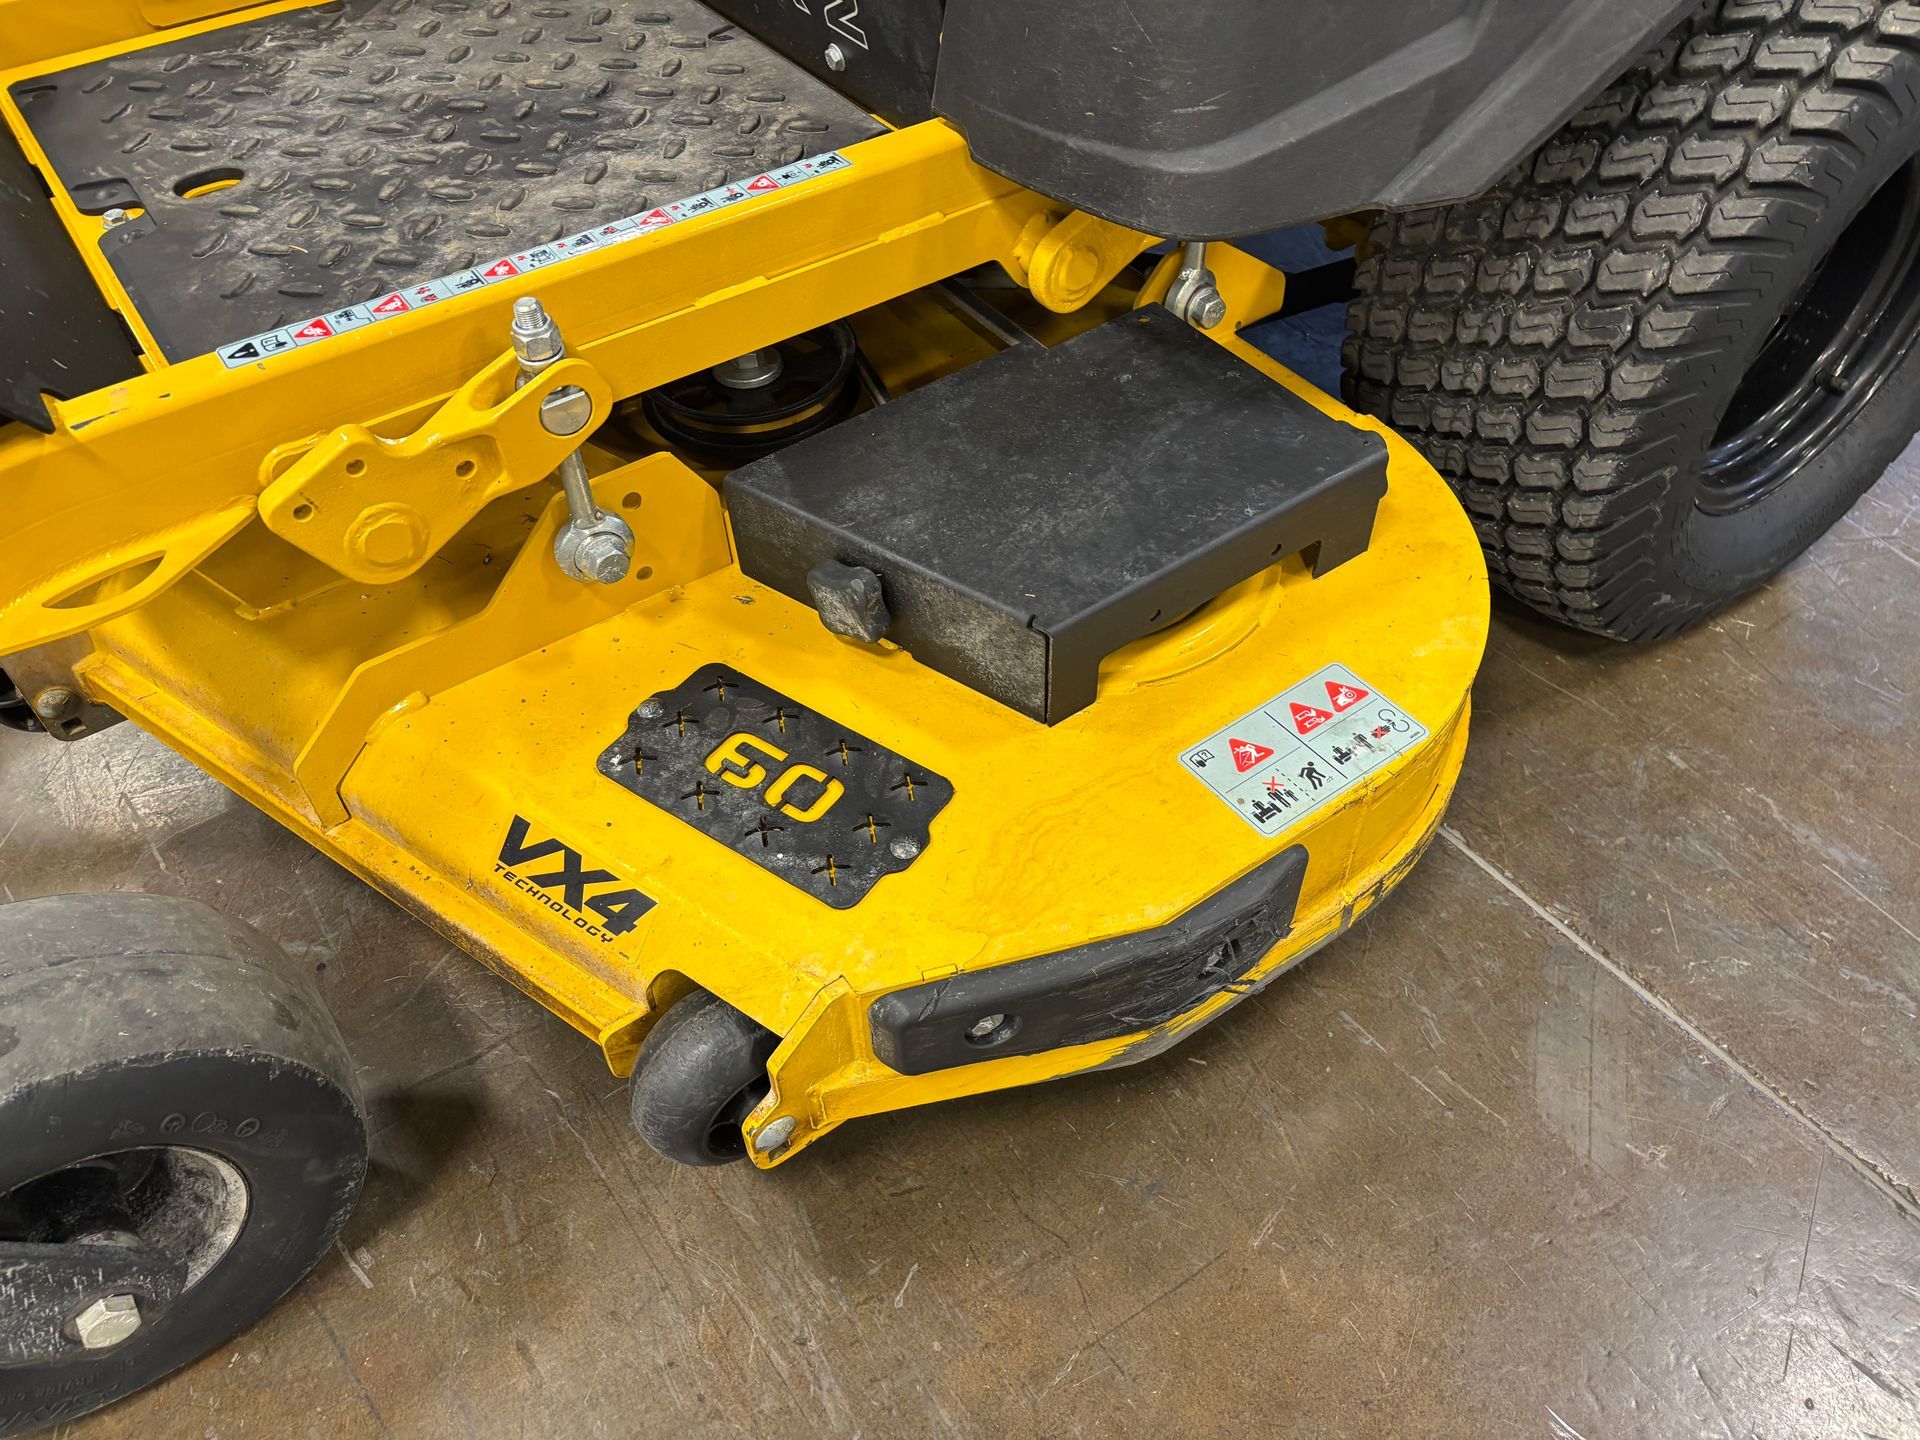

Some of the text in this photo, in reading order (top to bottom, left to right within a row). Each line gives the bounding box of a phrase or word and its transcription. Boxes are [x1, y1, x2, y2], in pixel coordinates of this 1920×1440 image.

[704, 732, 845, 823] 60
[493, 863, 615, 944] TECHNOLOGY
[498, 814, 658, 936] VX4
